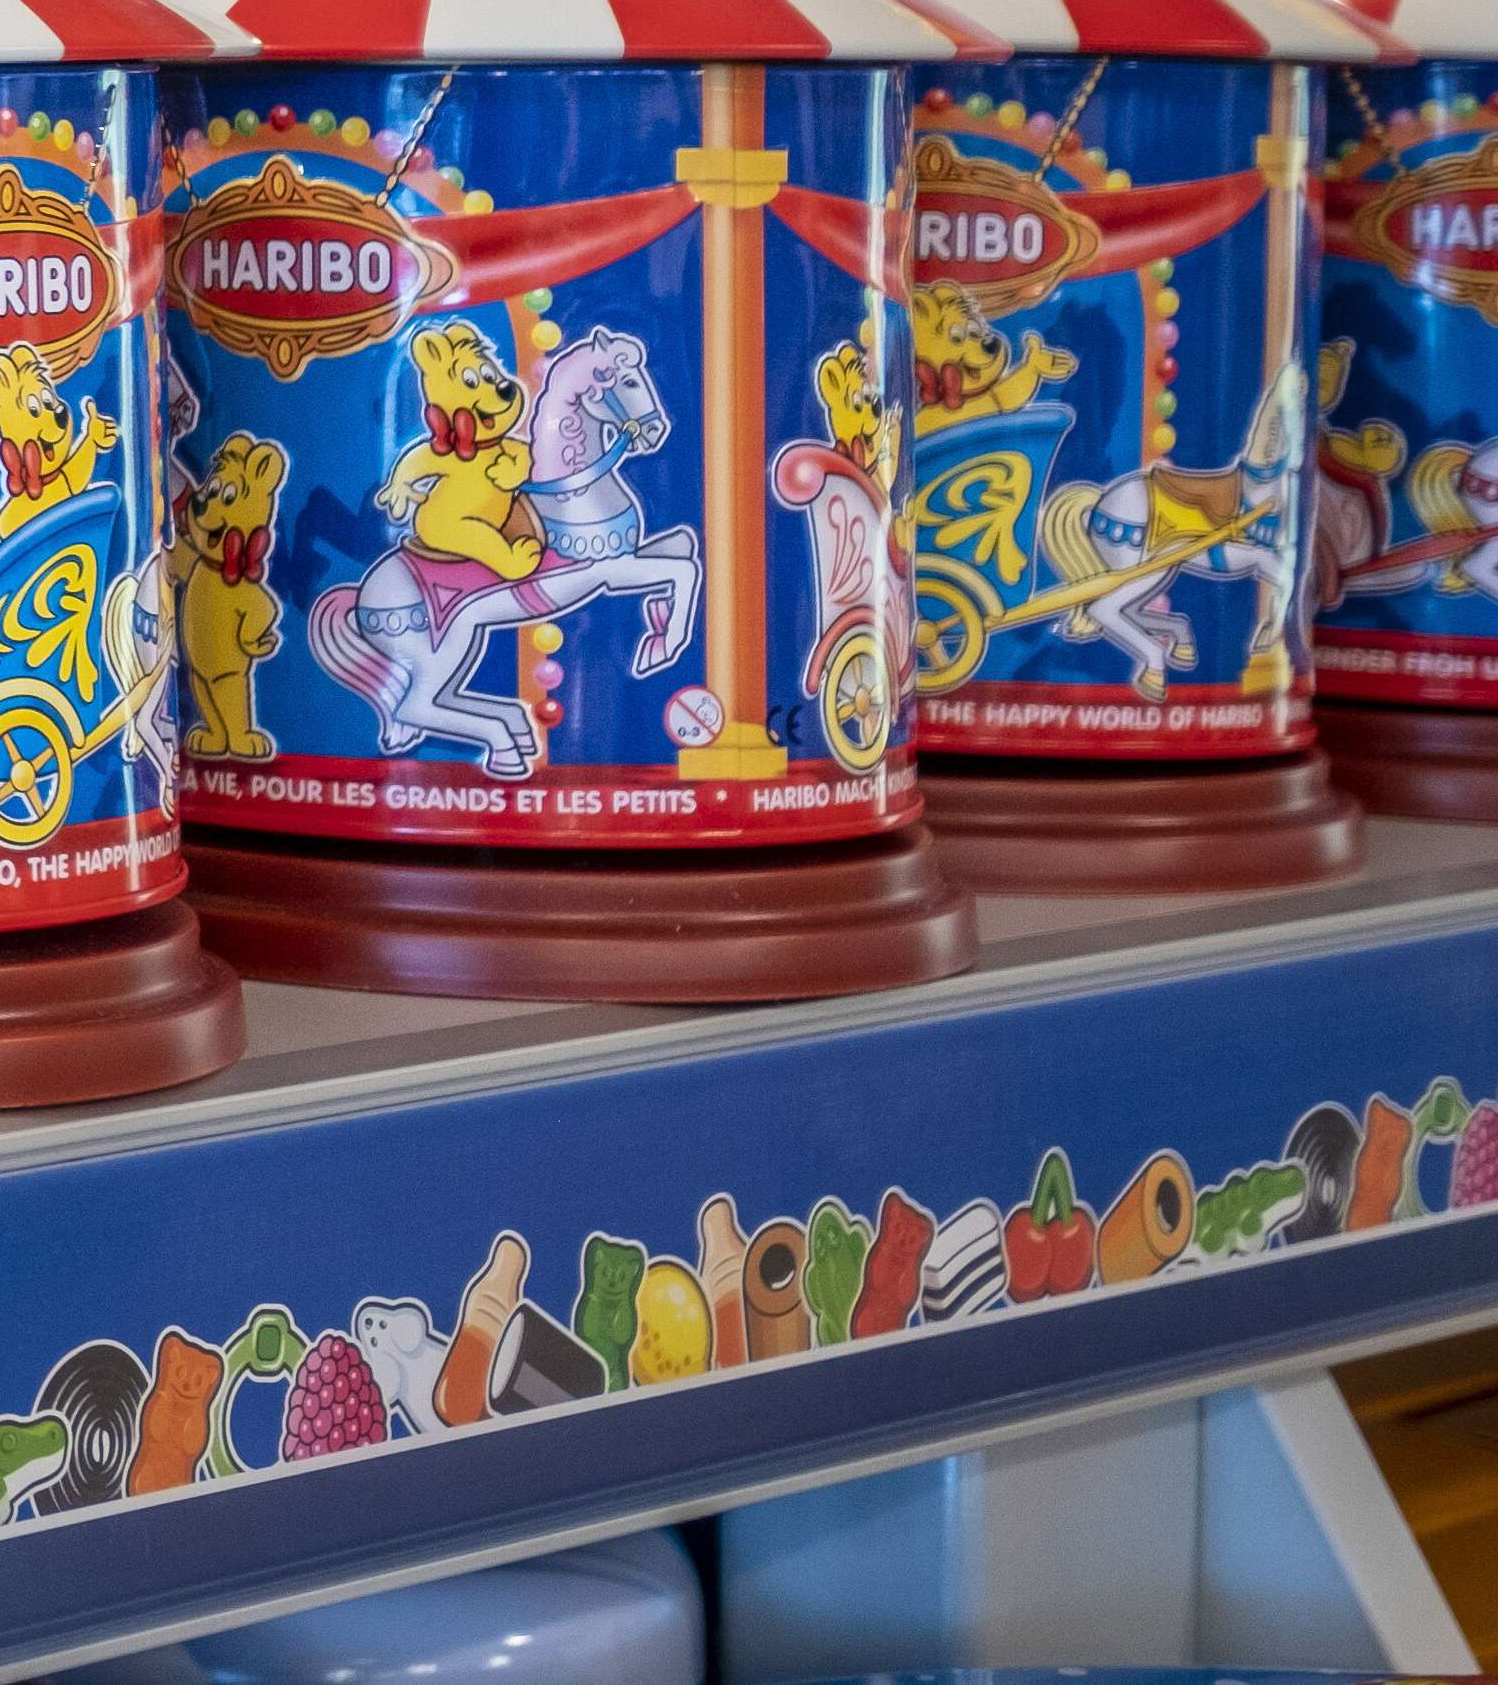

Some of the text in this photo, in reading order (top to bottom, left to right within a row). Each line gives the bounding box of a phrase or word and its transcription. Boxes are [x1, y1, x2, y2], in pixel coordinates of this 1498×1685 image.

[1413, 203, 1498, 251] HAR
[202, 240, 391, 293] HARIBO
[925, 699, 976, 726] THE
[985, 702, 1072, 729] HAPPY
[1077, 703, 1162, 731] WORLD
[1168, 704, 1193, 730] OF
[203, 770, 243, 800] VIE,
[249, 776, 323, 804] POUR
[332, 781, 376, 808] LES
[385, 785, 507, 813] GRANDS
[517, 789, 548, 813] ET
[556, 790, 603, 815] LES
[612, 789, 697, 815] PETITS
[753, 781, 830, 812] HARIBO
[29, 853, 70, 882] THE
[75, 843, 136, 876] HAPPY
